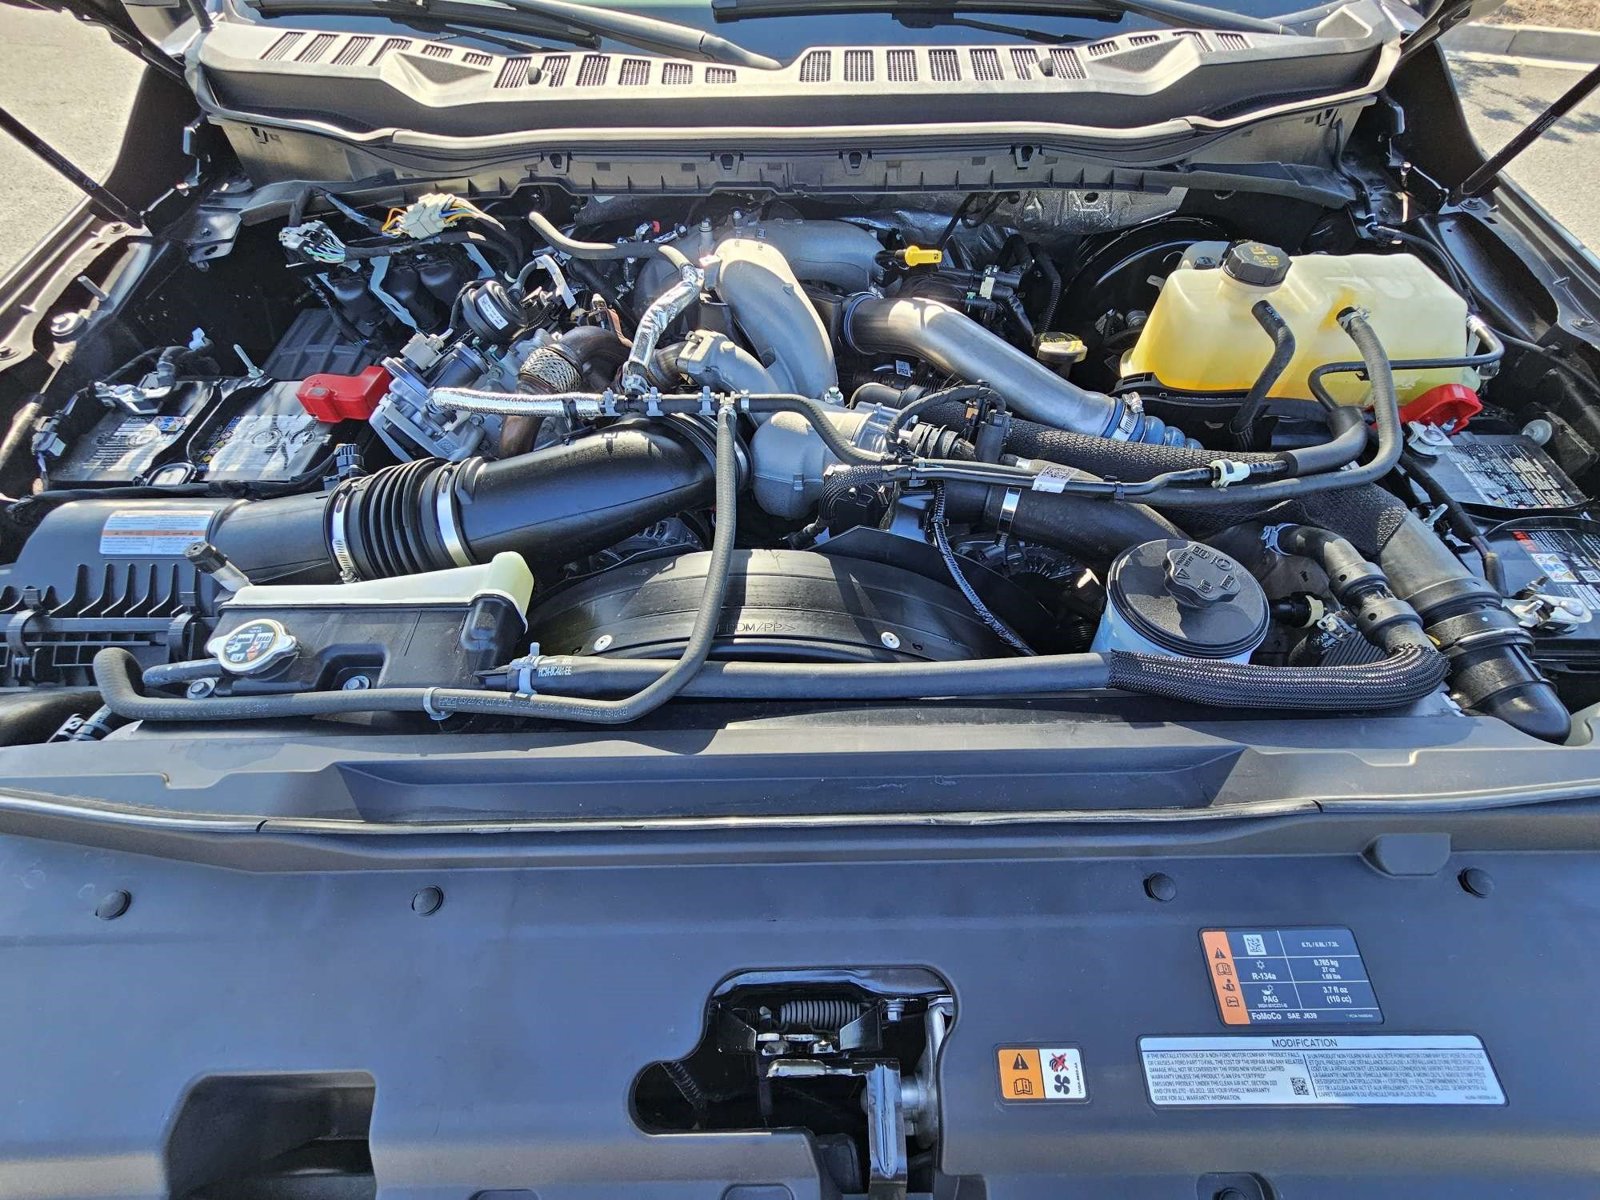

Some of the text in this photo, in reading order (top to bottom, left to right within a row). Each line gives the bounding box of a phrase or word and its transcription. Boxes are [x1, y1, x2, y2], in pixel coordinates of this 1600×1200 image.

[1330, 959, 1339, 968] kg
[1252, 972, 1276, 980] R-134a
[1323, 986, 1332, 994] 3.7
[1333, 986, 1339, 994] fl
[1326, 996, 1352, 1004] (110 cc)
[1251, 1012, 1282, 1020] FoMoCo
[1271, 1039, 1337, 1047] MODIFICATION
